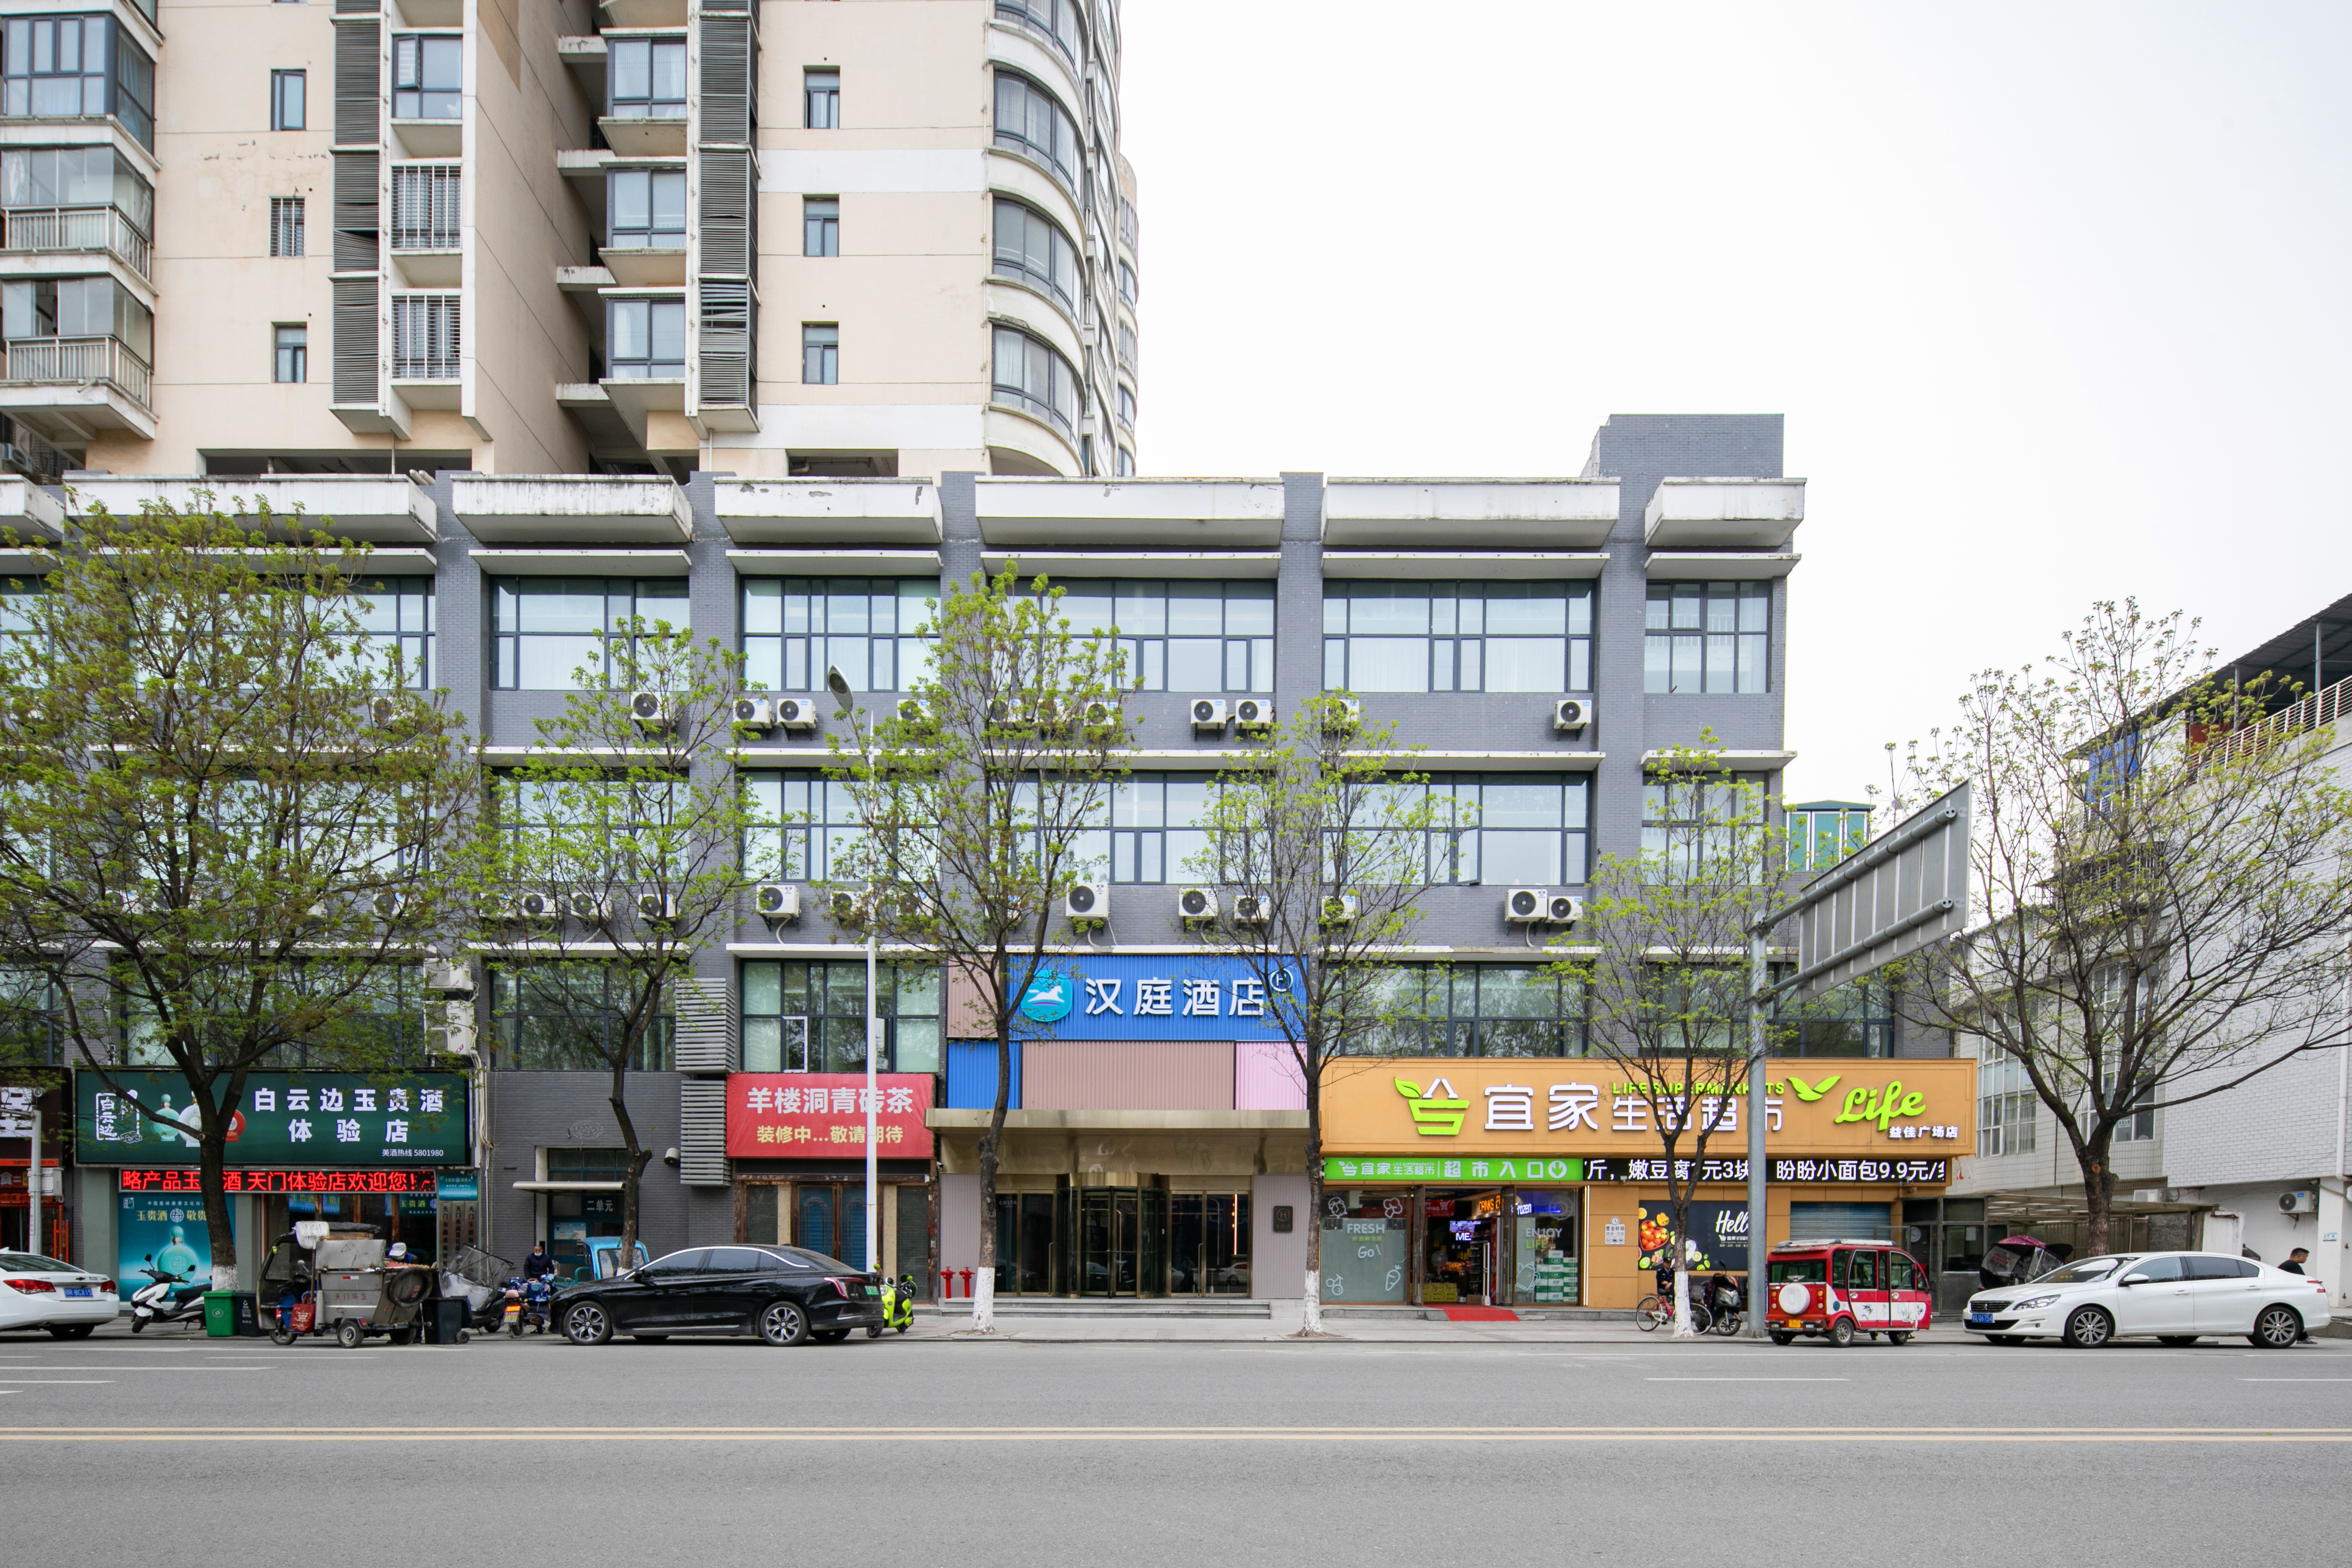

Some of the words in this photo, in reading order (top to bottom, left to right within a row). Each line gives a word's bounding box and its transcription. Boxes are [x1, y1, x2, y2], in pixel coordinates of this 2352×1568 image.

[1085, 977, 1265, 1016] 汉庭酒店
[1612, 1082, 1648, 1094] LIFE
[254, 1087, 443, 1113] 白云边玉贵酒
[747, 1087, 913, 1114] 羊楼洞青砖茶
[1834, 1080, 1926, 1131] Life
[1484, 1083, 1599, 1131] 宜家
[288, 1119, 409, 1143] 体验店
[1889, 1126, 1959, 1138] 益佳广场店
[382, 1148, 413, 1157] 美酒热线
[1361, 1162, 1391, 1175] 宜家
[1393, 1166, 1435, 1175] 生活超市
[1444, 1160, 1544, 1178] 超市入口
[123, 1170, 241, 1191] 略产品玉酒
[587, 1199, 613, 1212] 二单元
[136, 1210, 168, 1221] 玉贵酒
[1715, 1210, 1749, 1233] Hell
[1347, 1223, 1385, 1233] FRESH
[1526, 1228, 1562, 1237] ENJOY
[1526, 1239, 1547, 1249] LIFE
